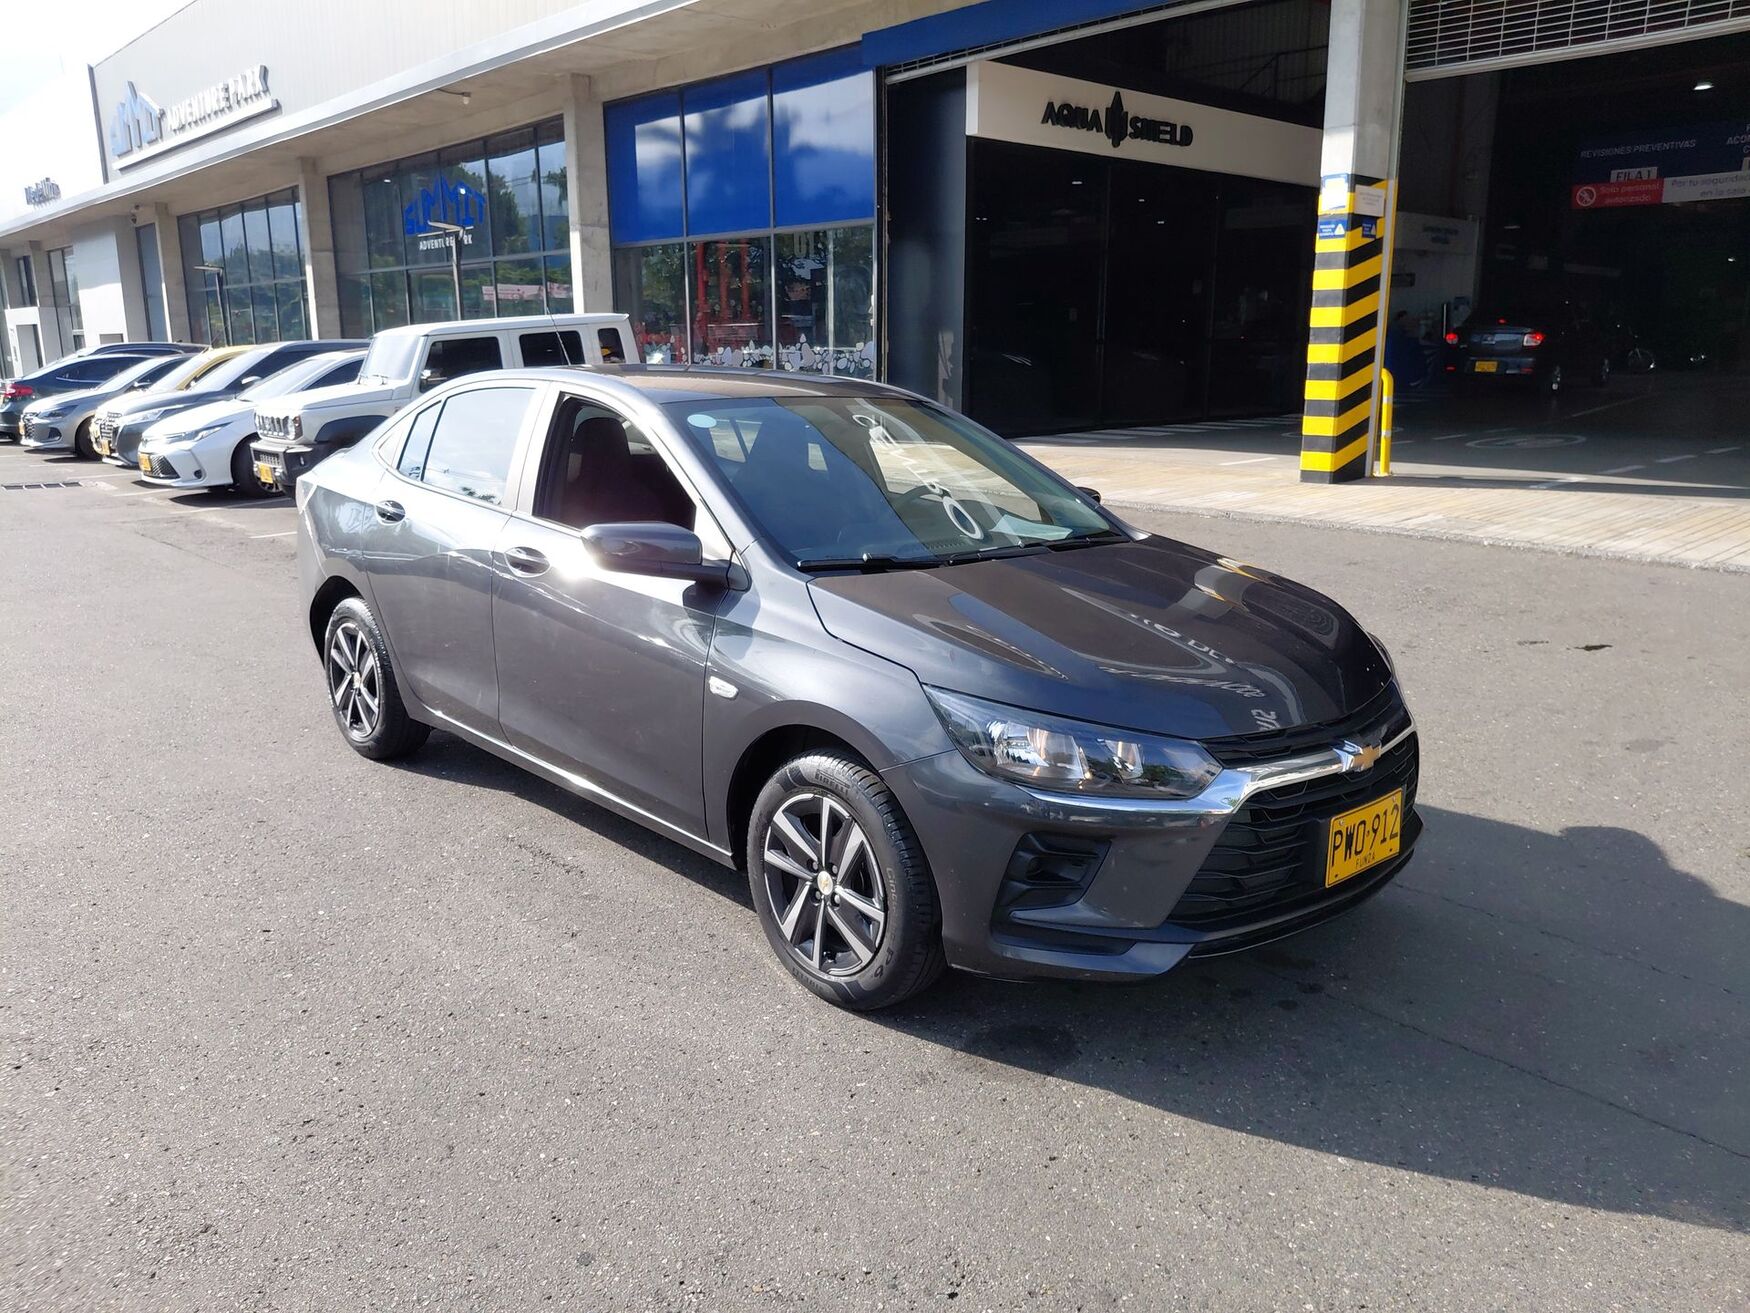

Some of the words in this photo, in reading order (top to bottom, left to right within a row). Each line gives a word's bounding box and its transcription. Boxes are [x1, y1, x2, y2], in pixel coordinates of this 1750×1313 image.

[228, 64, 271, 107] PARK
[1580, 147, 1633, 158] REVISIONES
[1632, 138, 1697, 153] PREVENTIVAS
